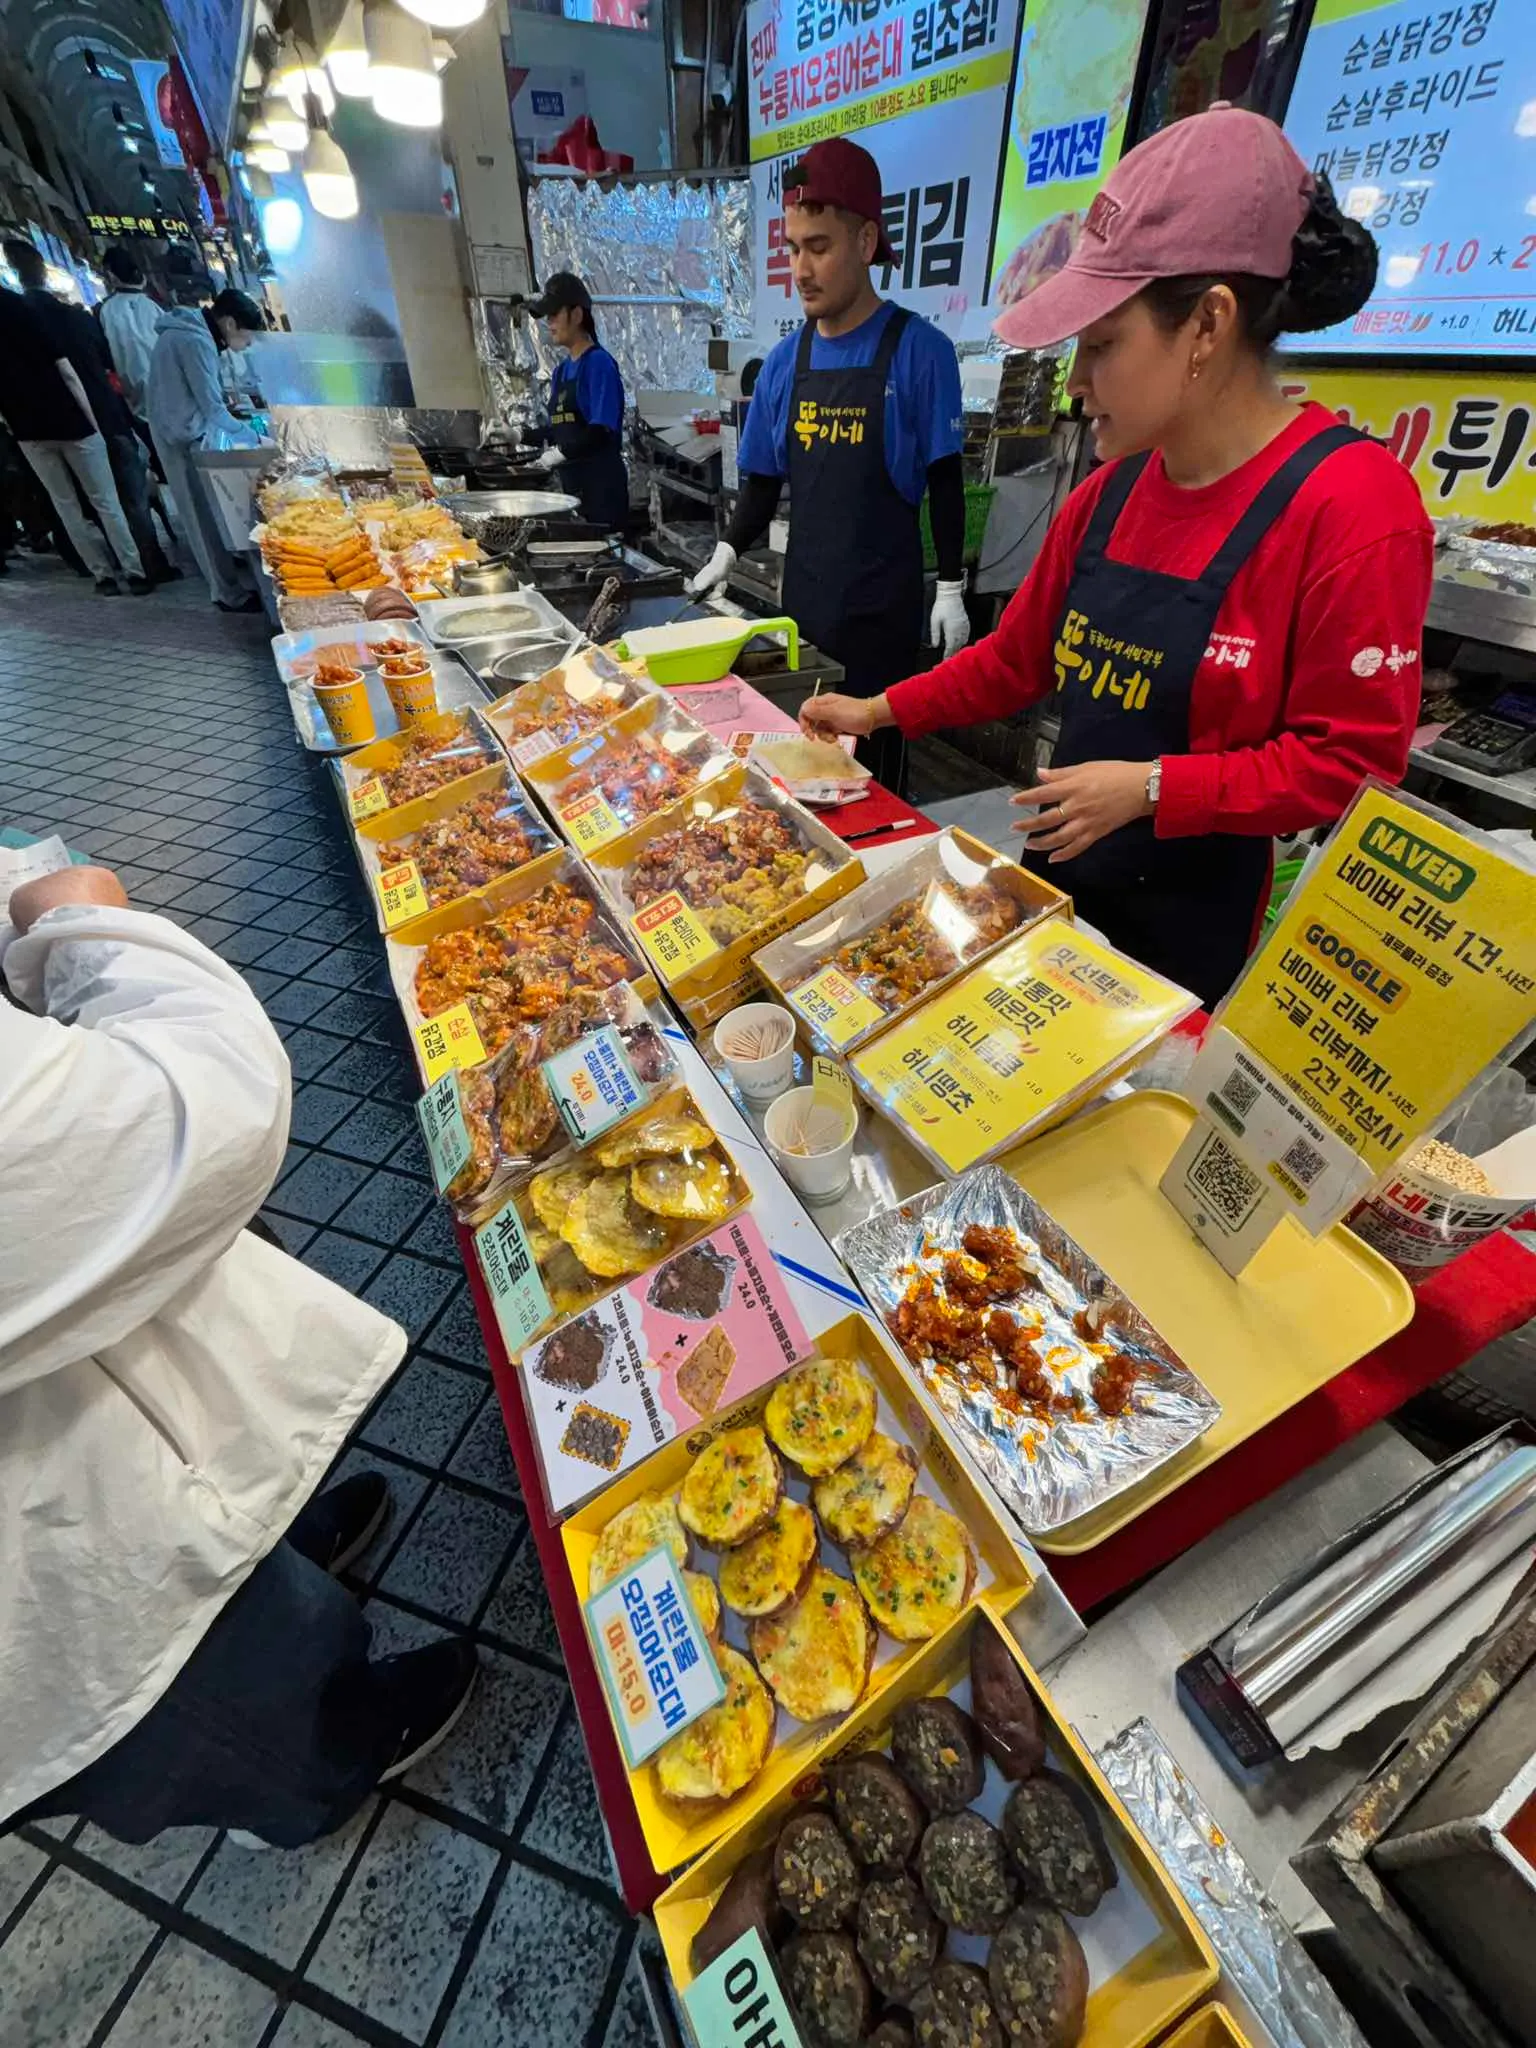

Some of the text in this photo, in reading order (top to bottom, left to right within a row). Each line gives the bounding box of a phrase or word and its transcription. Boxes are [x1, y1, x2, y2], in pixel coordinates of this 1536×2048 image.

[1343, 0, 1497, 76] 순살닭강정
[760, 17, 904, 126] 누룽지오징어순대
[1326, 60, 1504, 133] 순살후라이드
[870, 92, 904, 119] 10분정도
[1027, 117, 1107, 184] 감자전
[1418, 239, 1480, 276] 11.0
[1352, 310, 1411, 334] 매운맛
[1441, 315, 1470, 329] +1.0
[794, 401, 865, 451] 똑이네
[1054, 609, 1150, 710] 똑이네
[1369, 823, 1464, 893] NAVER
[671, 916, 701, 950] 후라이드
[1336, 854, 1404, 911] 네이버
[1399, 896, 1456, 942] 리뷰
[1452, 930, 1503, 975] 1건
[1048, 948, 1079, 969] 맛
[1069, 963, 1119, 995] 선택
[1305, 923, 1402, 1005] GOOGLE
[1424, 961, 1455, 987] 증정
[800, 989, 838, 1022] 닭강정
[820, 976, 856, 1007] 반마리
[983, 987, 1047, 1036] 매운맛
[1279, 948, 1379, 1036] 네이버 리뷰
[421, 1023, 447, 1060] 닭강정
[448, 1018, 471, 1041] 순살
[1266, 981, 1313, 1028] +구글
[1309, 1018, 1392, 1094] 리뷰까지
[435, 1076, 457, 1128] 누룽지
[572, 1073, 593, 1102] 24.0
[902, 1048, 976, 1115] 허니땡초
[1302, 1058, 1404, 1151] 2건 작성시
[482, 1232, 510, 1299] 오징어순대
[495, 1209, 530, 1285] 계란물
[738, 1282, 756, 1310] 24.0
[615, 1356, 631, 1385] 24.0
[653, 1580, 700, 1674] 계란물
